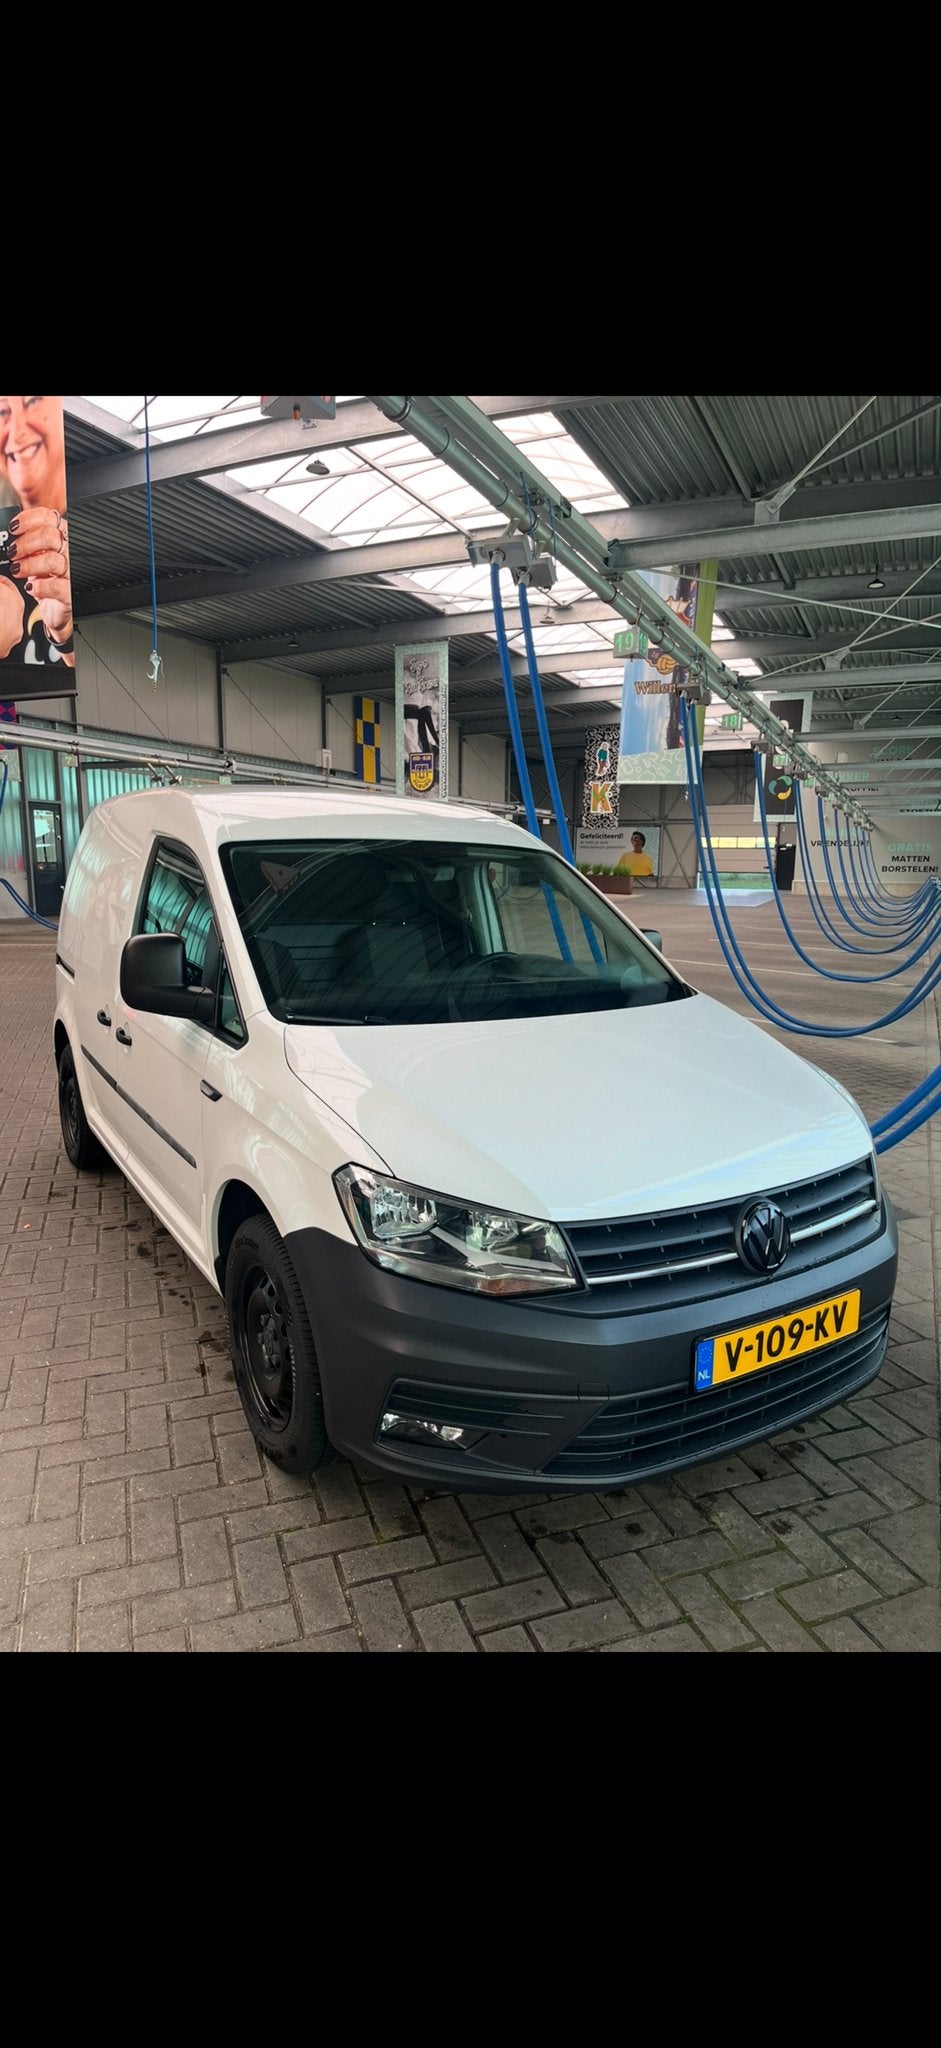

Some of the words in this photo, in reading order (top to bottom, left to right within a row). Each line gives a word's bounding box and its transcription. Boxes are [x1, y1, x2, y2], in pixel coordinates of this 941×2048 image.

[615, 632, 635, 653] 19
[722, 715, 738, 729] 18
[888, 843, 933, 852] GRATIS
[881, 865, 938, 873] BORSTELEN!
[725, 1300, 848, 1372] V-109-KV
[698, 1370, 711, 1381] NL
